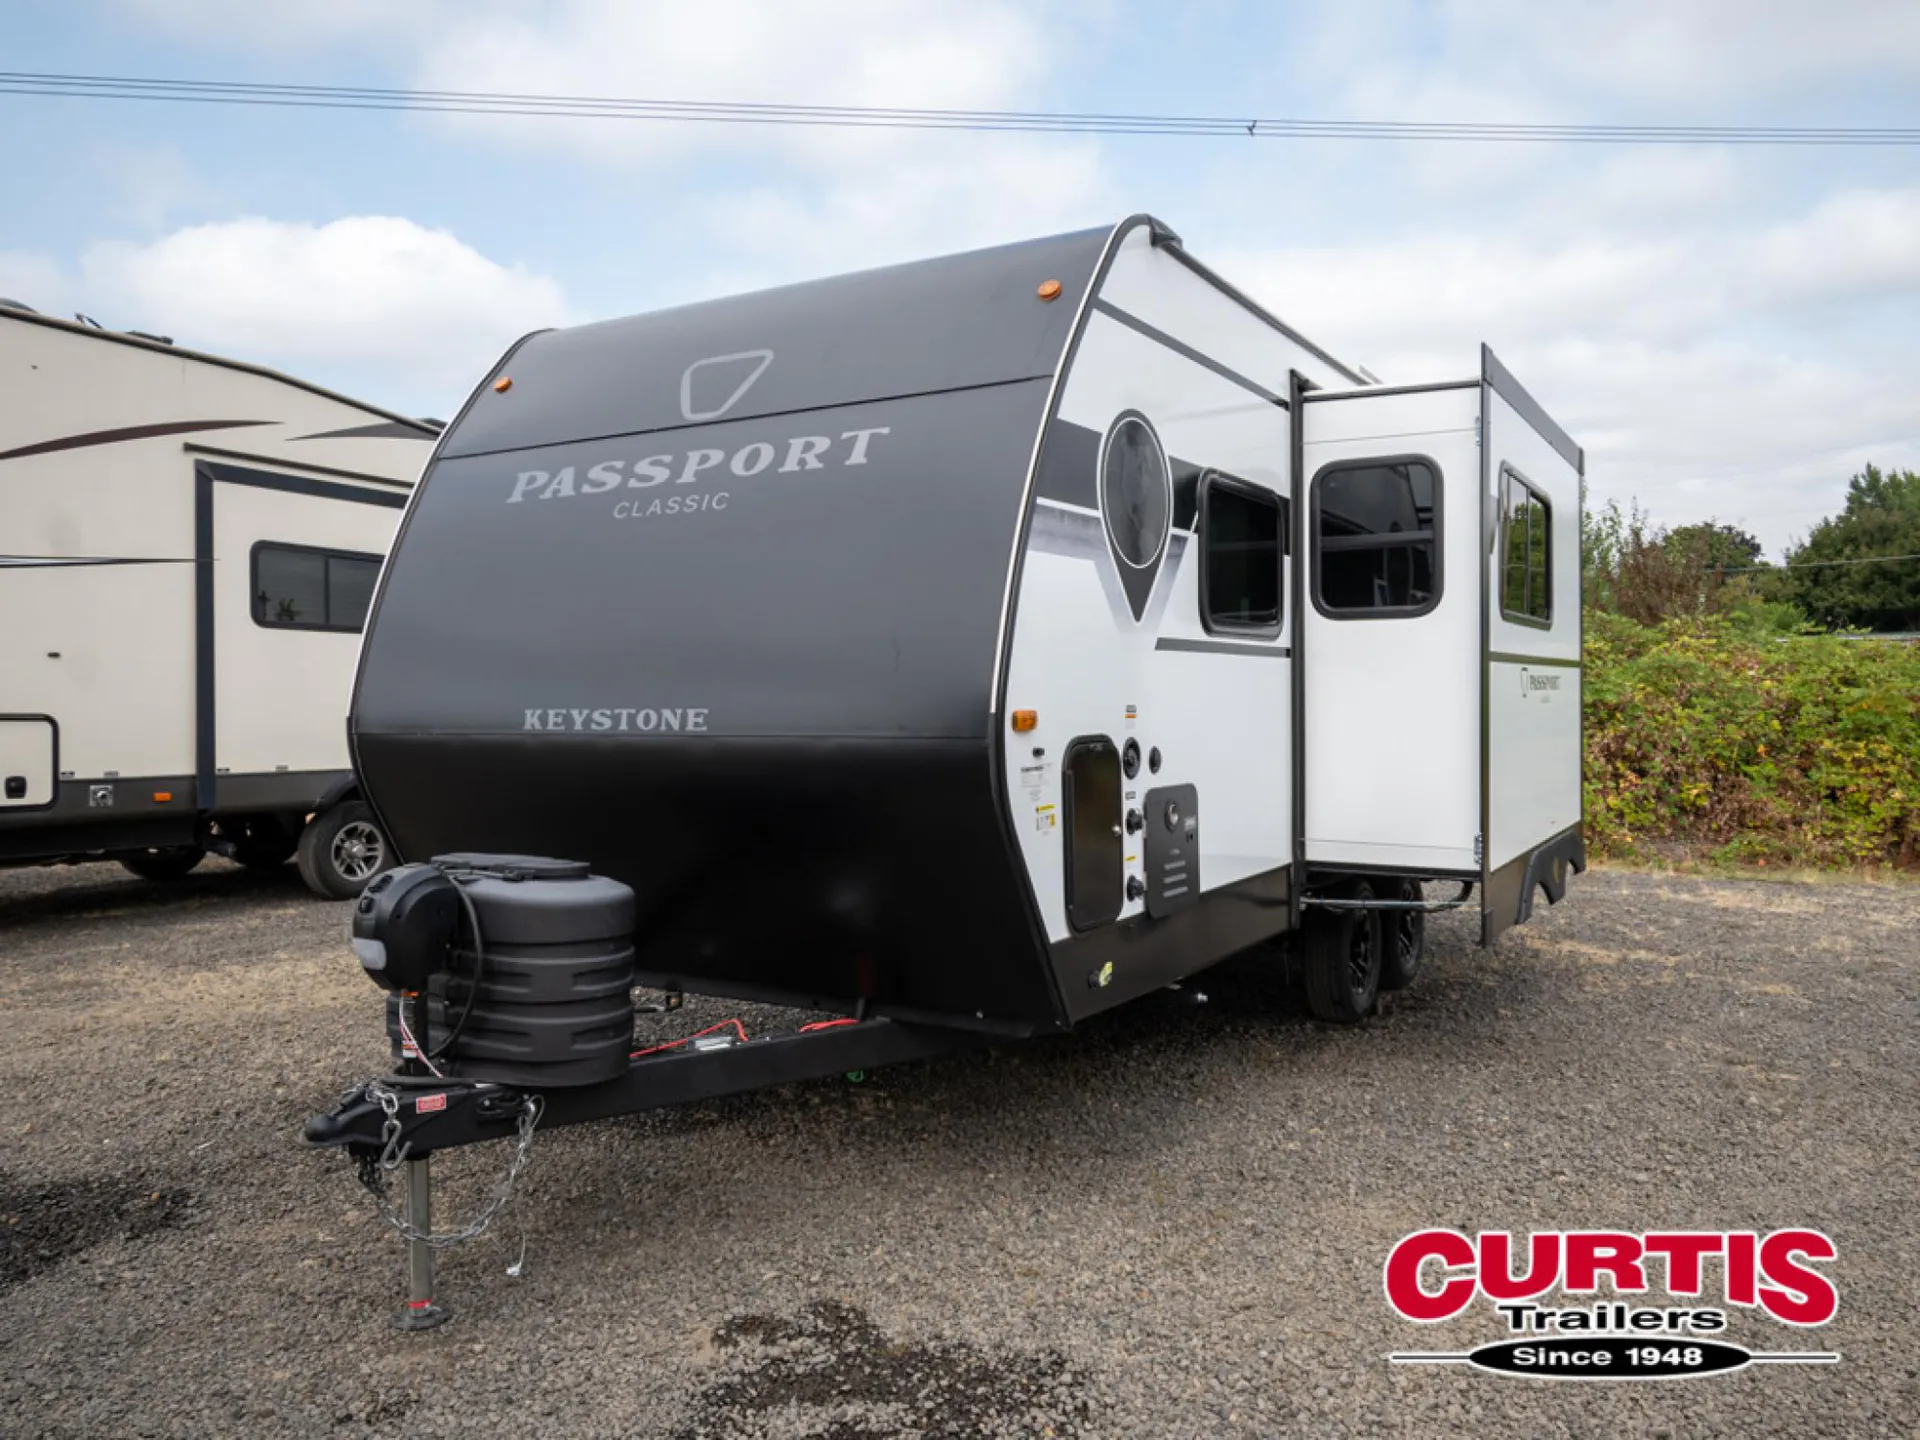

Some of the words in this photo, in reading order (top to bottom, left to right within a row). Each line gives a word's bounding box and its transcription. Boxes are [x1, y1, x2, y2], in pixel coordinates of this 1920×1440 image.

[506, 426, 891, 503] PASSPORT
[613, 492, 730, 519] CLASSIC
[523, 707, 709, 732] KEYSTONE
